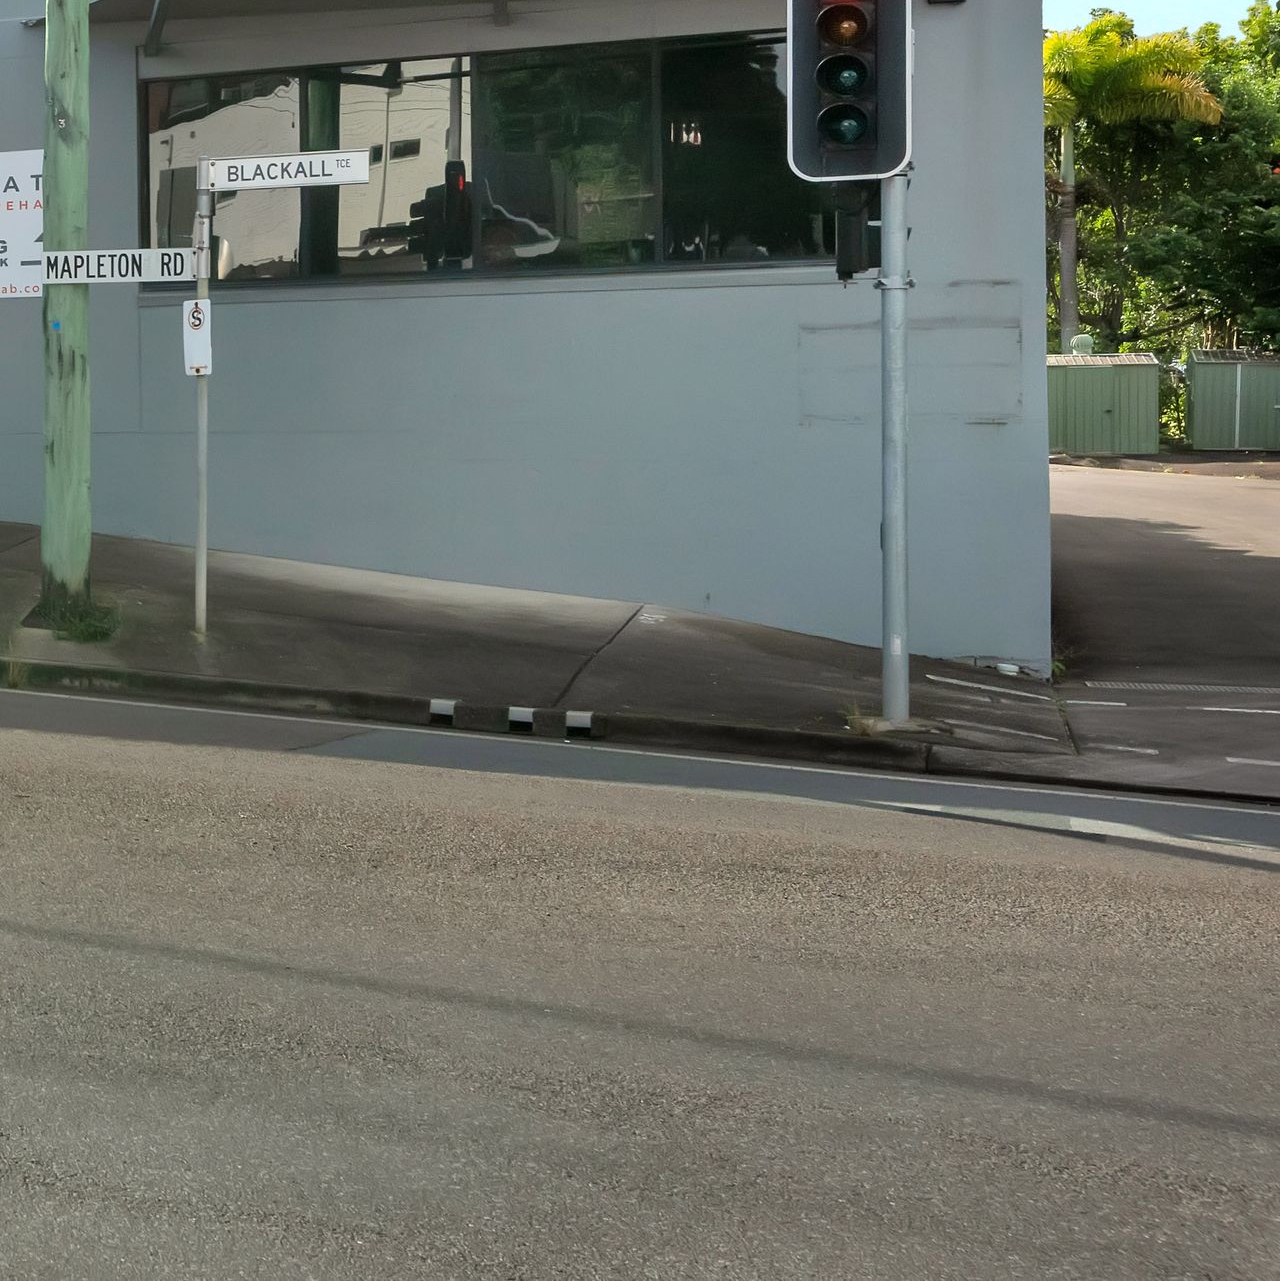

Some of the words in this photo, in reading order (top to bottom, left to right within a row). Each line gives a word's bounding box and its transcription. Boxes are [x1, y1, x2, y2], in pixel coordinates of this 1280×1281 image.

[227, 159, 333, 183] BLACKALL
[335, 158, 351, 169] TCE
[46, 253, 143, 280] MAPLETON
[160, 252, 185, 276] RD
